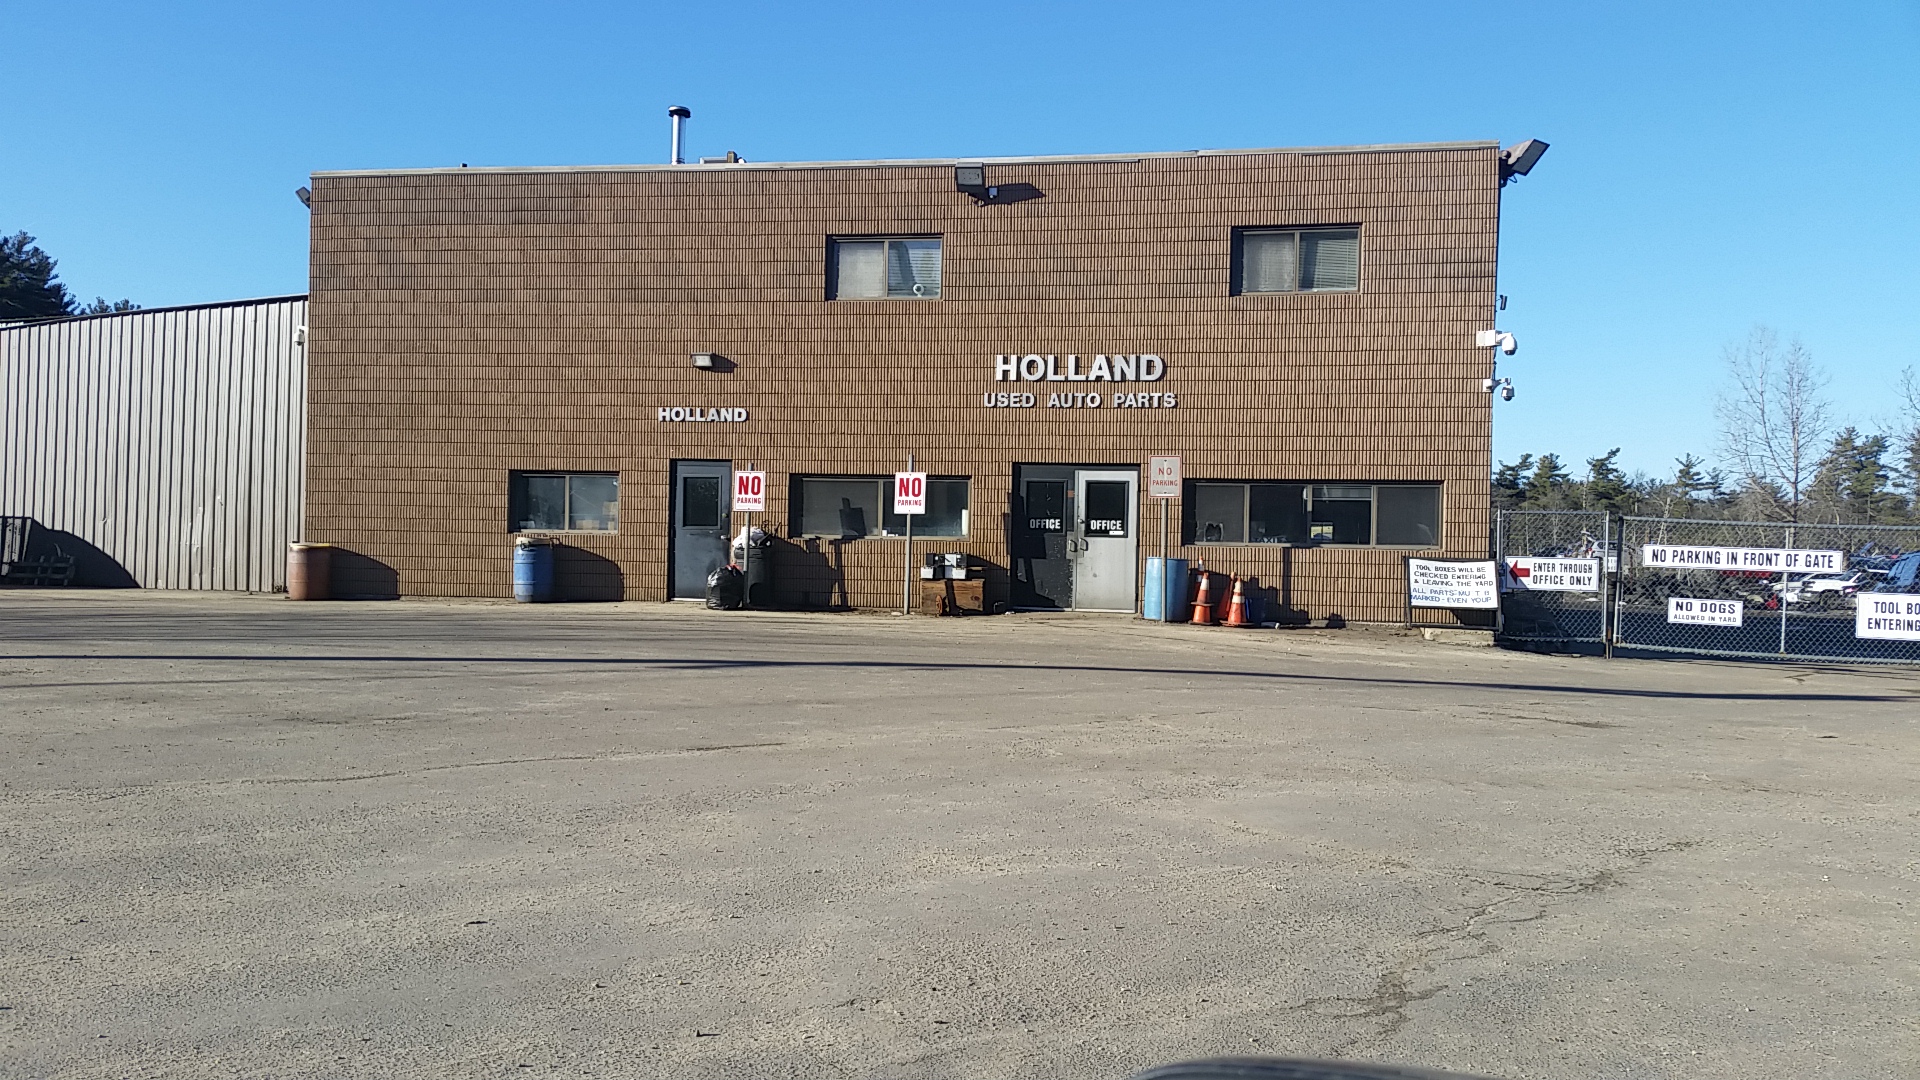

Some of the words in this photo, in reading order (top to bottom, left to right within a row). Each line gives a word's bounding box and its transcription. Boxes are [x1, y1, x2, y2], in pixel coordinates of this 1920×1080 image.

[995, 354, 1164, 381] HOLLAND
[984, 393, 1035, 408] USED
[1048, 393, 1101, 408] AUTO
[1113, 393, 1176, 408] PARTS
[658, 407, 748, 421] HOLLAND
[1158, 467, 1172, 476] NO
[738, 475, 761, 495] NO
[899, 477, 922, 497] NO
[1152, 479, 1178, 487] PARKING
[898, 499, 922, 507] PARKING
[1029, 518, 1061, 529] OFFICE
[1090, 519, 1122, 530] OFFICE
[1651, 549, 1667, 563] NO
[1672, 549, 1721, 565] PARKING
[1726, 551, 1738, 566] IN
[1744, 552, 1781, 567] FRONT
[1785, 553, 1799, 568] OF
[1805, 554, 1834, 569] GATE
[1533, 562, 1556, 573] ENTER
[1559, 563, 1593, 574] THROUGH
[1413, 571, 1449, 580] CHECKED
[1532, 574, 1565, 585] OFFICE
[1569, 575, 1593, 586] ONLY
[1422, 578, 1454, 587] LEAVING
[1412, 587, 1426, 595] ALL
[1410, 594, 1441, 602] MARKED
[1675, 600, 1693, 612] NO
[1700, 602, 1736, 615] DOGS
[1873, 601, 1902, 614] TOOL
[1673, 613, 1706, 621] ALLOWED
[1867, 617, 1920, 631] ENTERING
